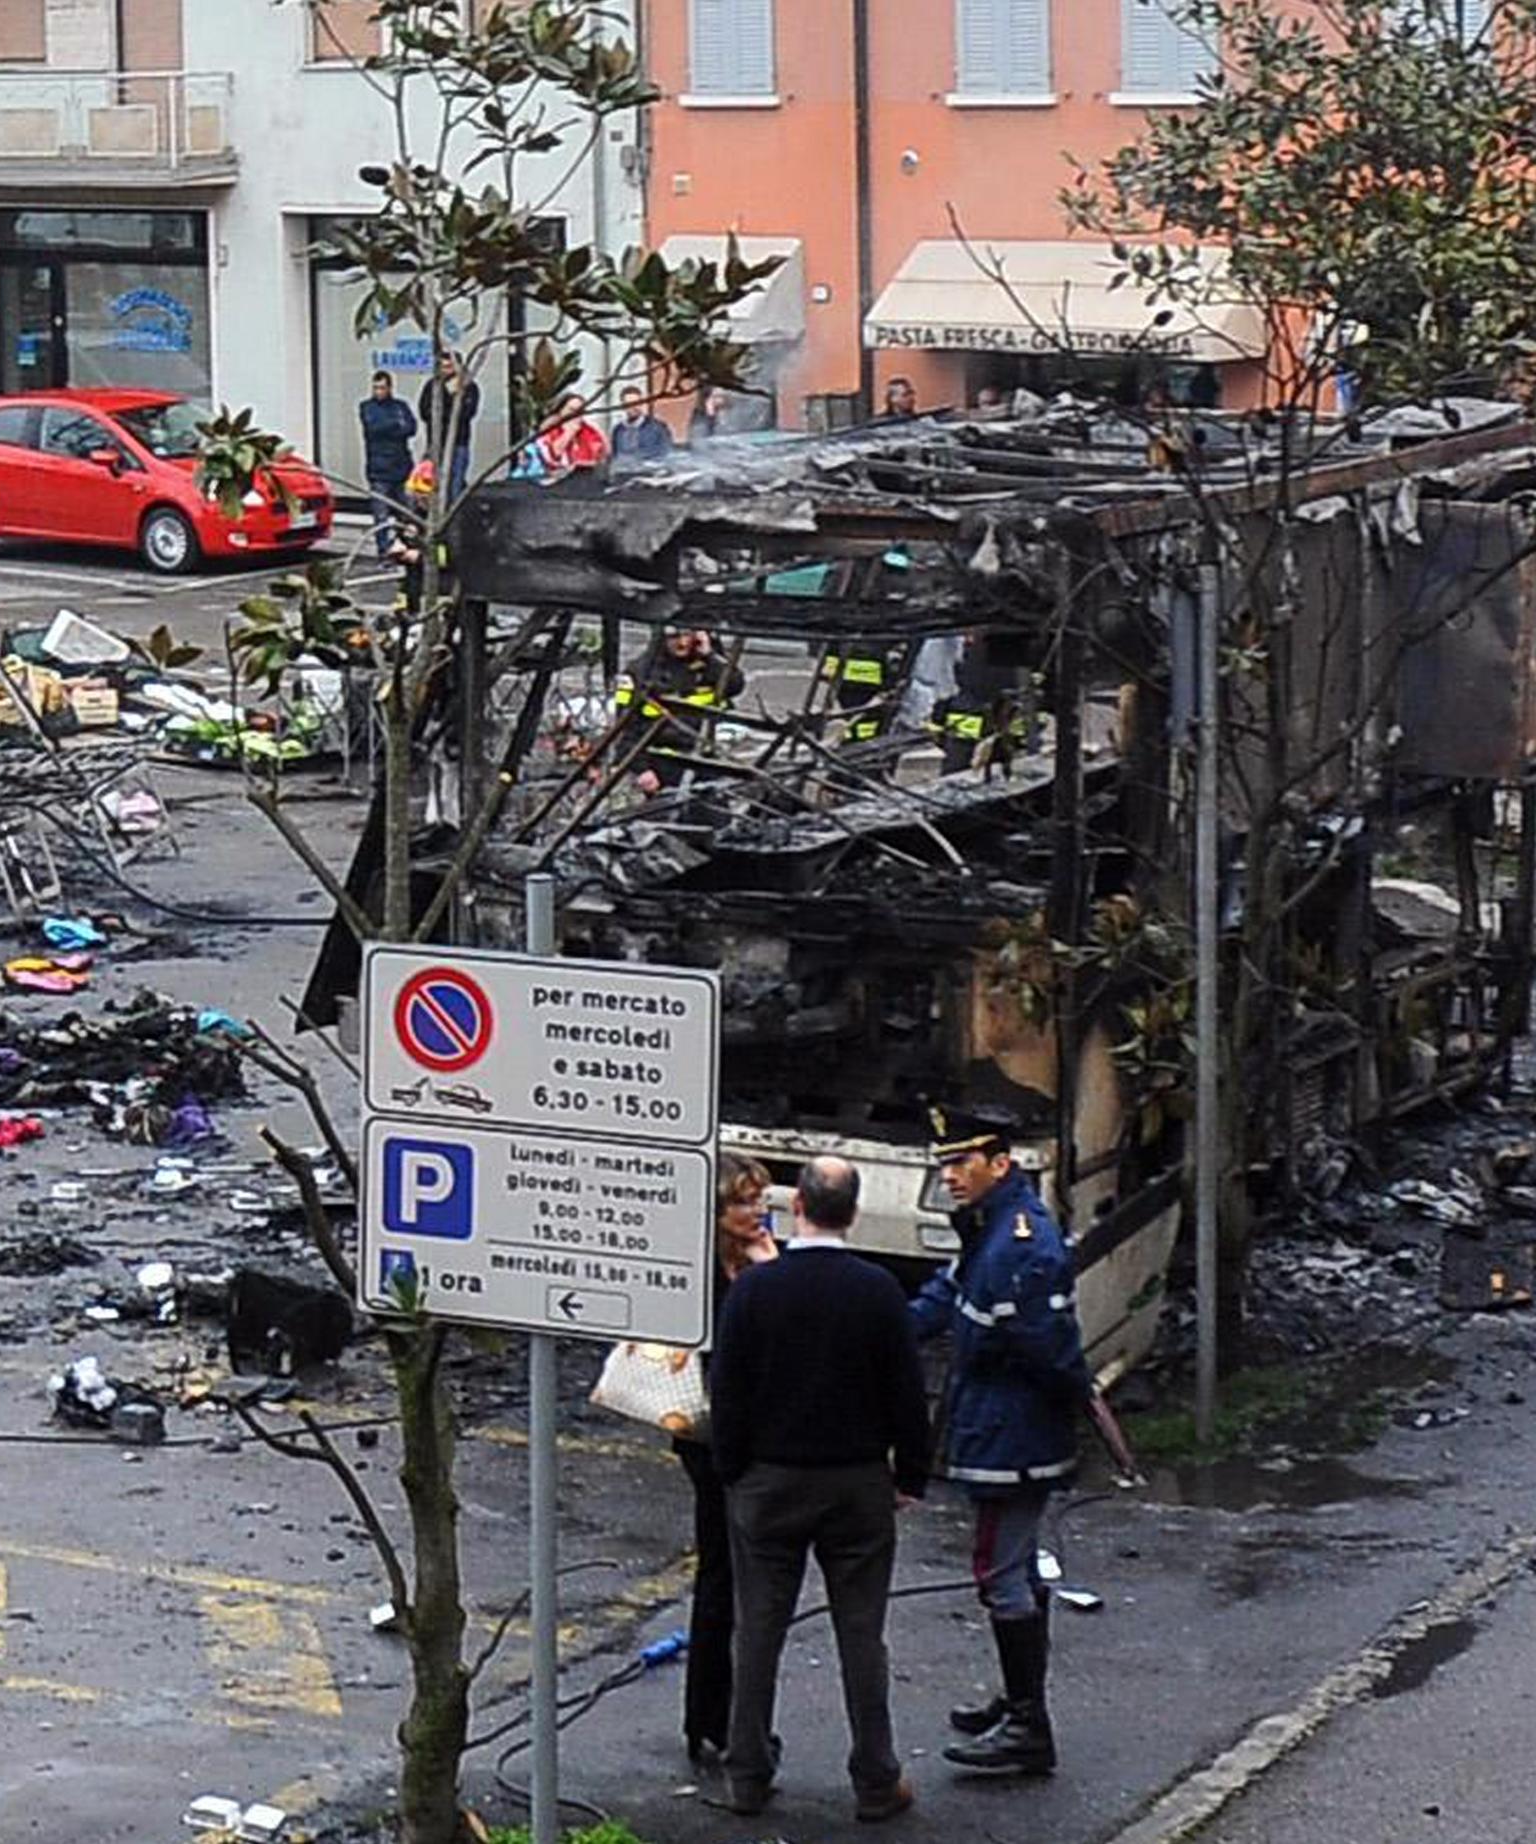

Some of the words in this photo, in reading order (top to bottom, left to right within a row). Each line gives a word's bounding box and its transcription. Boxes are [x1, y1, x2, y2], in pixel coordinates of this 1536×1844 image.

[875, 326, 935, 346] PASTA
[943, 327, 1018, 348] FRESCA
[532, 987, 574, 1007] per
[582, 991, 686, 1017] mercato
[553, 1058, 568, 1075] e
[576, 1057, 662, 1084] sabato
[533, 1085, 589, 1111] 6.30
[613, 1093, 682, 1121] 15.00
[401, 1149, 455, 1224] P
[421, 1266, 430, 1287] 1
[440, 1273, 483, 1293] ora
